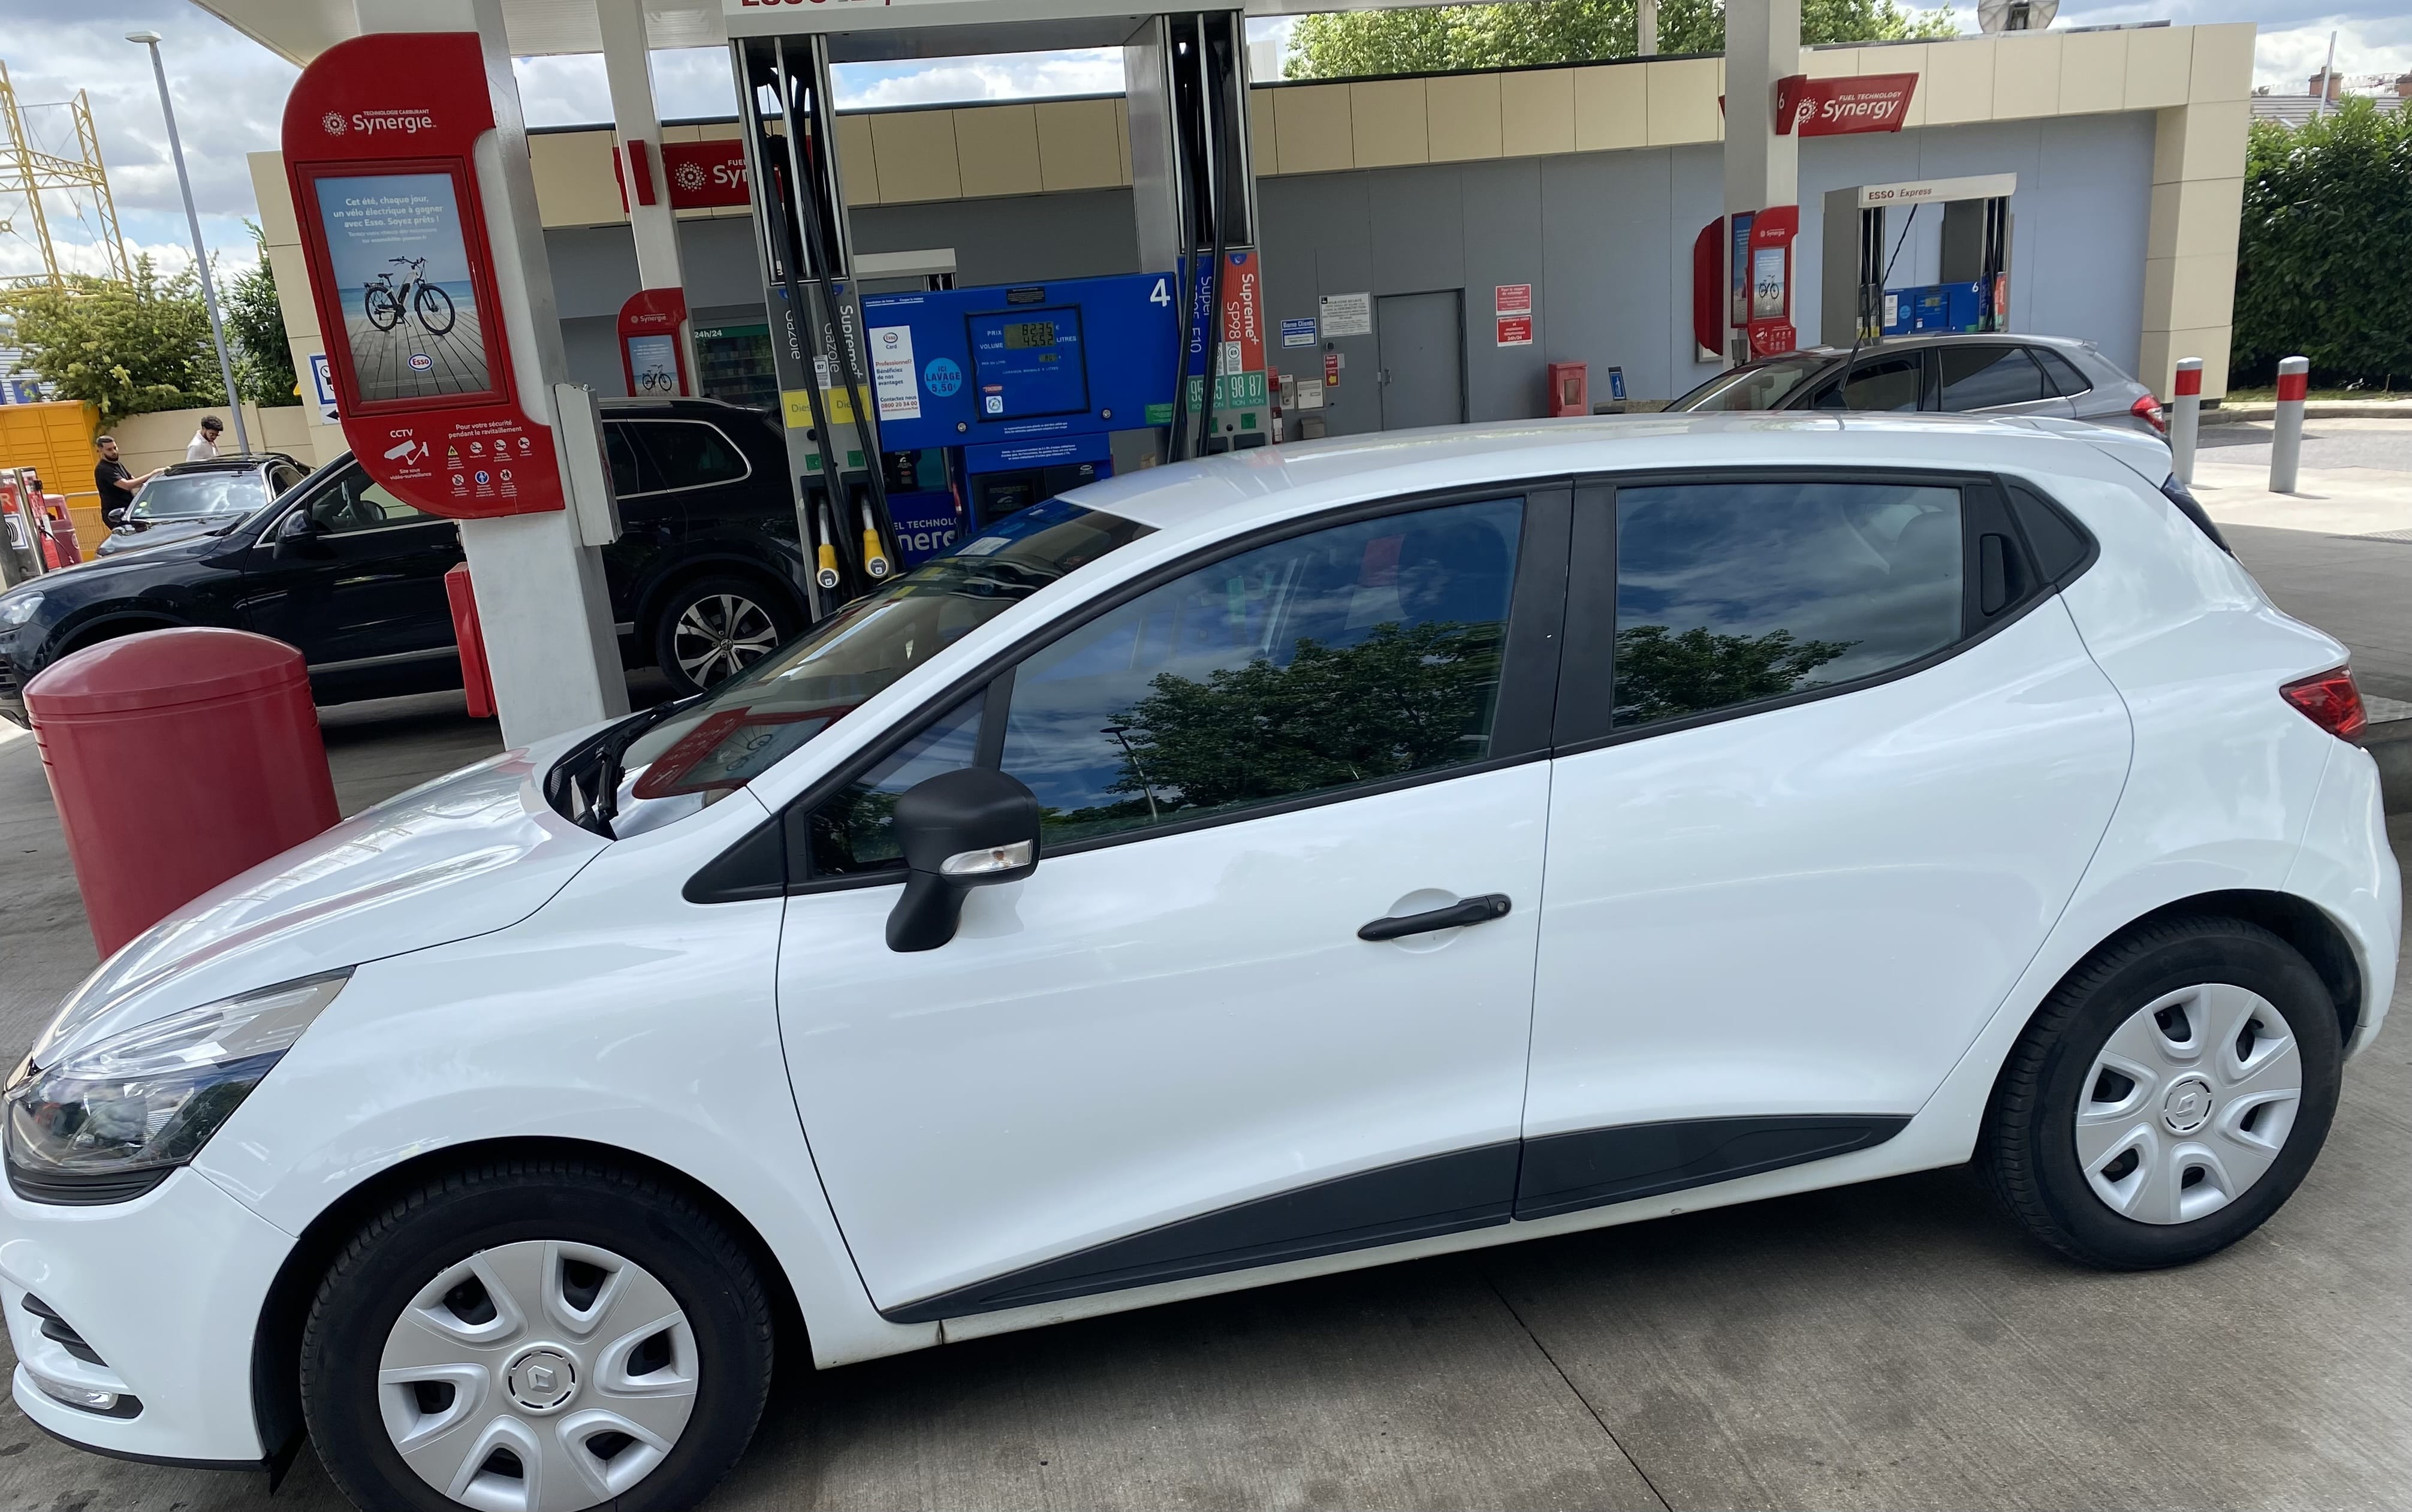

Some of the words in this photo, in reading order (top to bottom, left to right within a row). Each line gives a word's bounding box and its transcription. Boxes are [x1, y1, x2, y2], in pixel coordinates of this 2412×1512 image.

[1778, 92, 1784, 109] 6
[1858, 91, 1903, 100] TECHNOLOGY
[1821, 99, 1900, 122] Synergy
[352, 113, 432, 135] Synergie
[346, 198, 360, 206] Cet
[379, 196, 410, 206] chaque
[411, 194, 429, 205] jour,
[1869, 190, 1894, 200] ESSO
[1900, 188, 1932, 198] Express
[366, 207, 406, 216] électrique
[415, 205, 444, 215] gagner
[387, 218, 412, 228] Soyez
[1150, 278, 1171, 307] 4
[1972, 282, 1979, 292] 6
[640, 315, 667, 324] Synergie
[1226, 301, 1241, 339] SP98
[694, 330, 723, 339] 24h/24
[824, 322, 840, 373] Gazole
[925, 372, 961, 382] LAVAGE
[1231, 376, 1244, 399] 98
[1249, 375, 1262, 396] 87
[791, 403, 811, 412] Dies
[489, 420, 512, 428] sécurité
[390, 428, 413, 438] CCTV
[448, 431, 474, 440] pendant
[481, 426, 523, 435] ravitaillement
[894, 522, 905, 530] EL
[906, 517, 957, 529] TECHNOL
